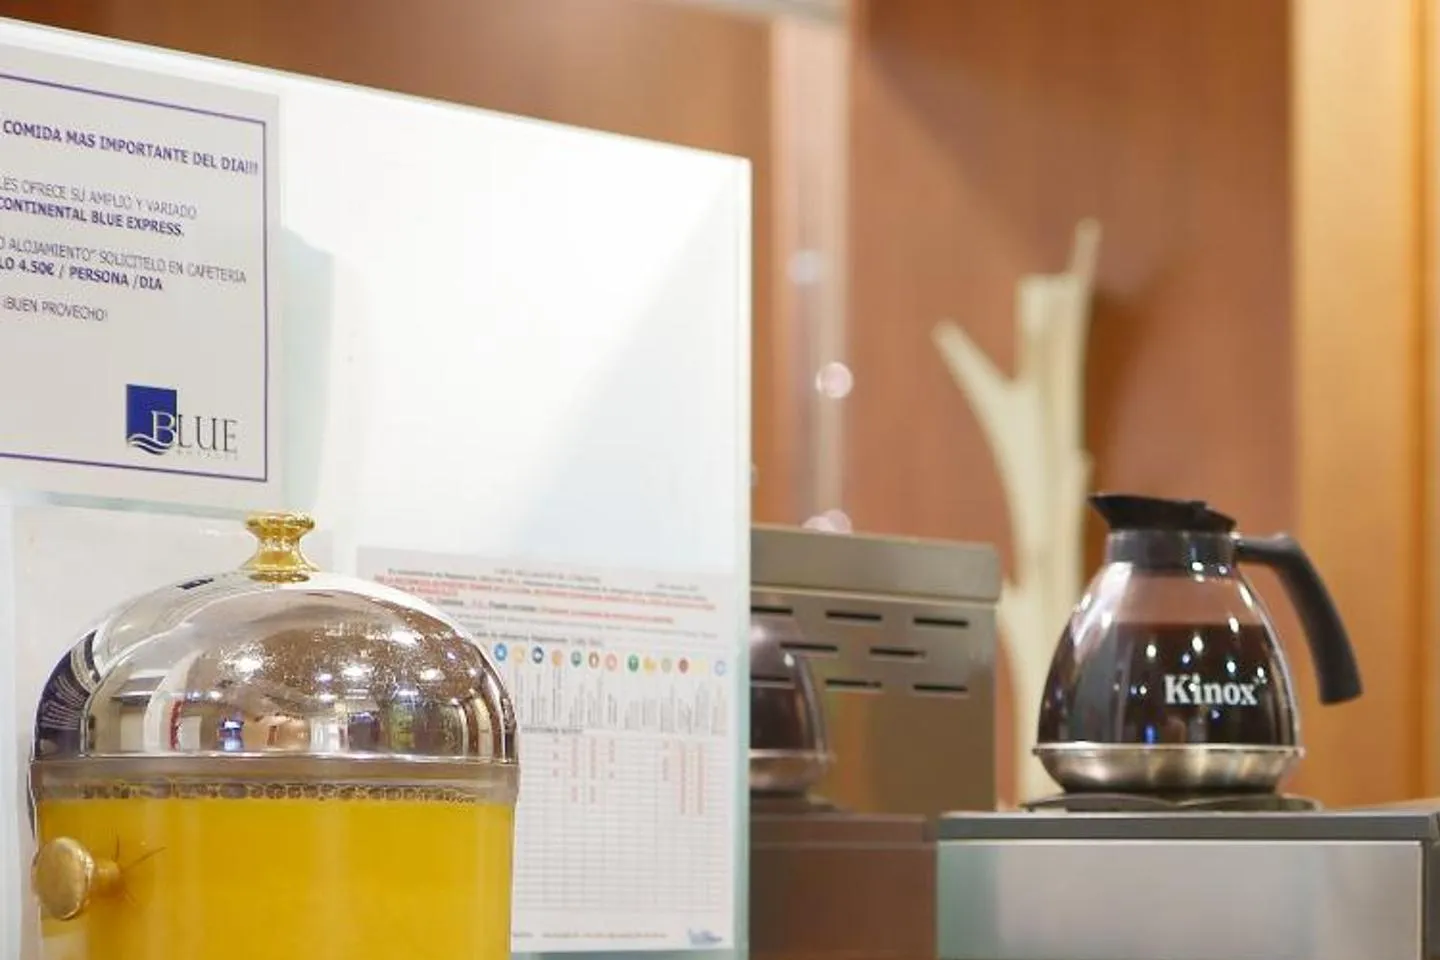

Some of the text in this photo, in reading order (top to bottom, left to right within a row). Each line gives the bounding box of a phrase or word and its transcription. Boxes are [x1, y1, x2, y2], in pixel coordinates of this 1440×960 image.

[3, 119, 62, 142] COMIDA
[66, 130, 96, 148] MAS
[100, 136, 189, 164] IMPORTANTE
[193, 152, 217, 169] DEL
[22, 180, 67, 201] OFRECE
[71, 186, 85, 202] SU
[90, 190, 132, 210] AMPLIO
[136, 198, 143, 211] Y
[148, 200, 198, 220] VARIADO
[91, 209, 123, 228] BLUE
[127, 216, 185, 237] EXPRESS.
[70, 267, 129, 288] PERSONA
[169, 261, 184, 276] EN
[151, 410, 238, 452] BLUE
[1164, 673, 1258, 705] Kinox
